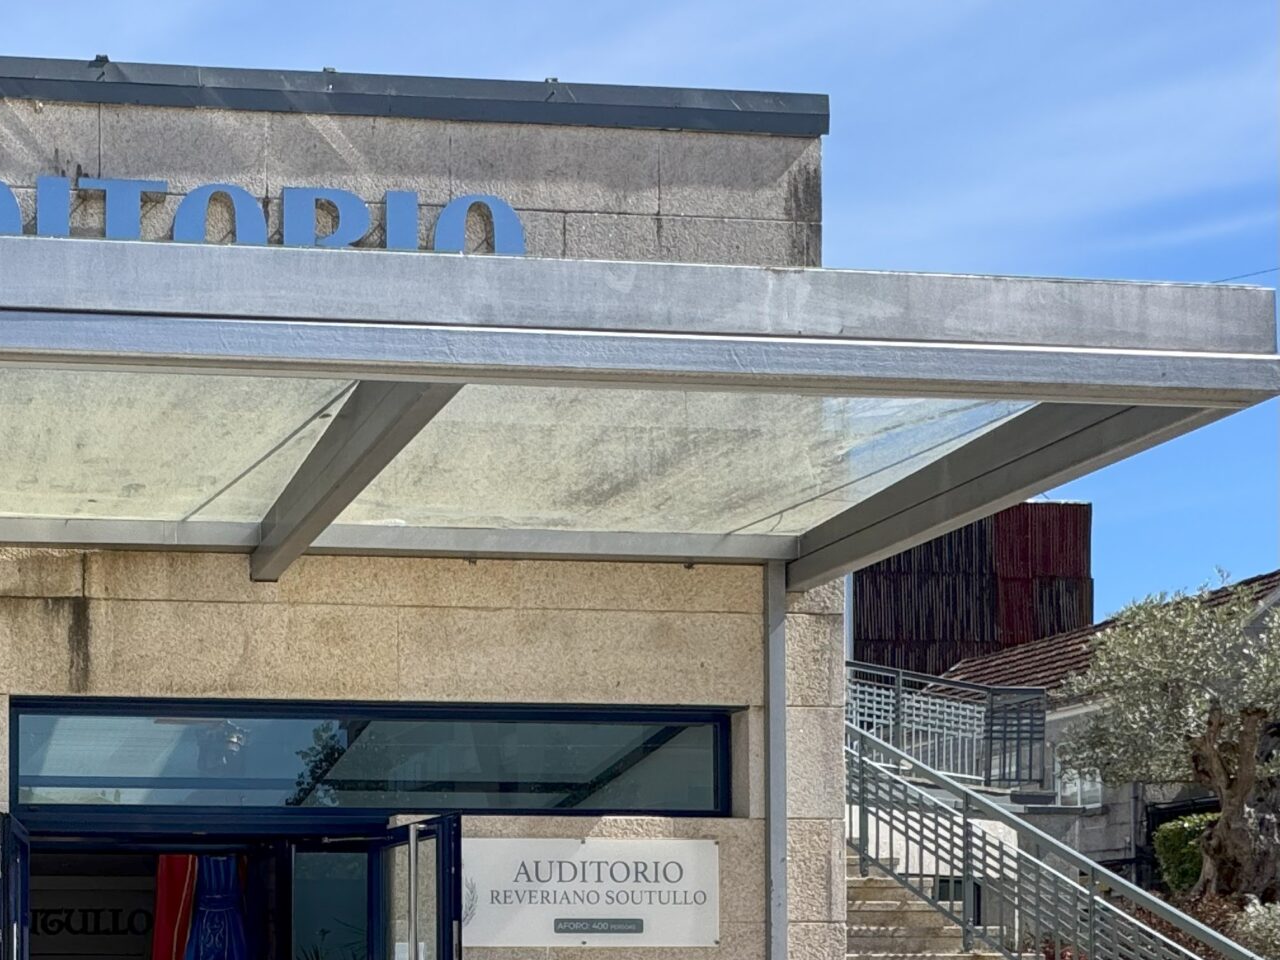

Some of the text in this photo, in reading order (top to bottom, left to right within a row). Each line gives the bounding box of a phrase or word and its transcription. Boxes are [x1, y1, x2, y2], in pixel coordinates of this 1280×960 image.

[513, 860, 684, 884] AUDITORIO
[490, 889, 707, 906] REVERIANO SOUTULLO
[592, 922, 609, 930] 400
